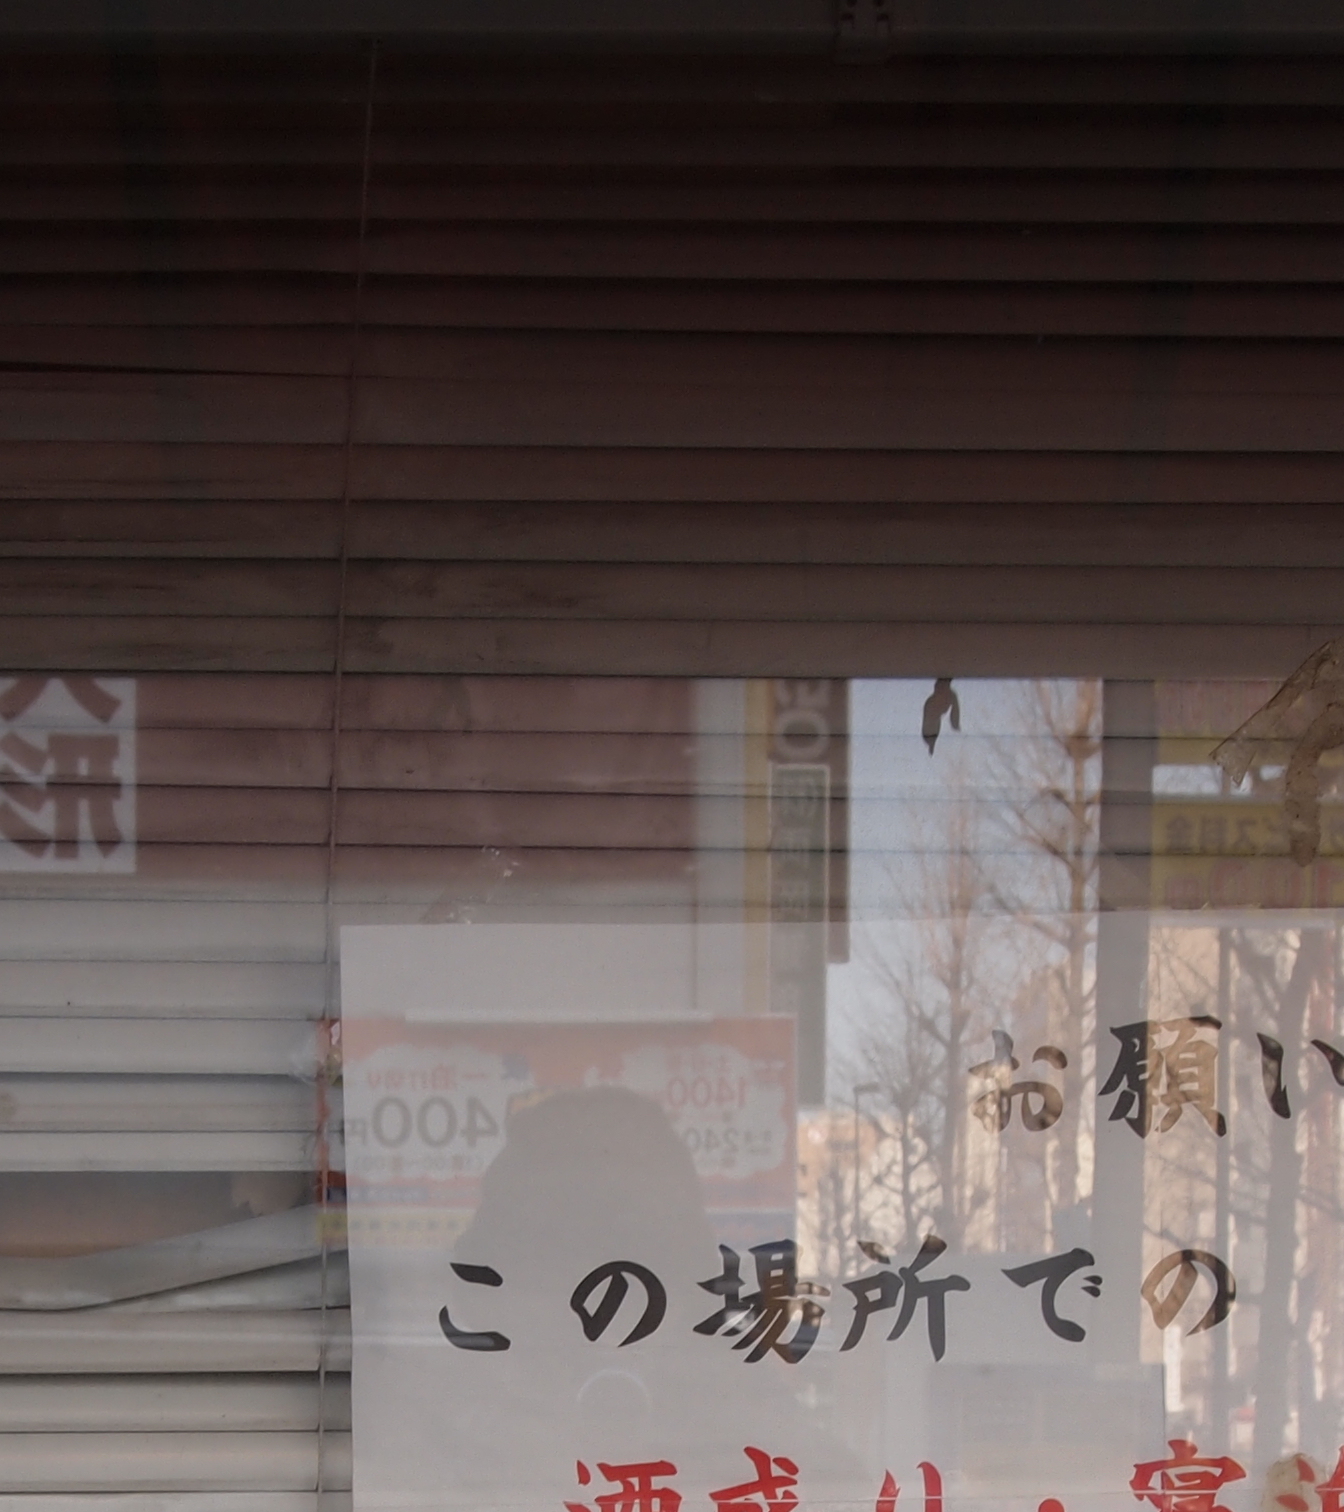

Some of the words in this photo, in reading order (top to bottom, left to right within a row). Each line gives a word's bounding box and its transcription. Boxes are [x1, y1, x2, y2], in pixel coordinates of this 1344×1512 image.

[437, 1238, 1238, 1364] この場所での
